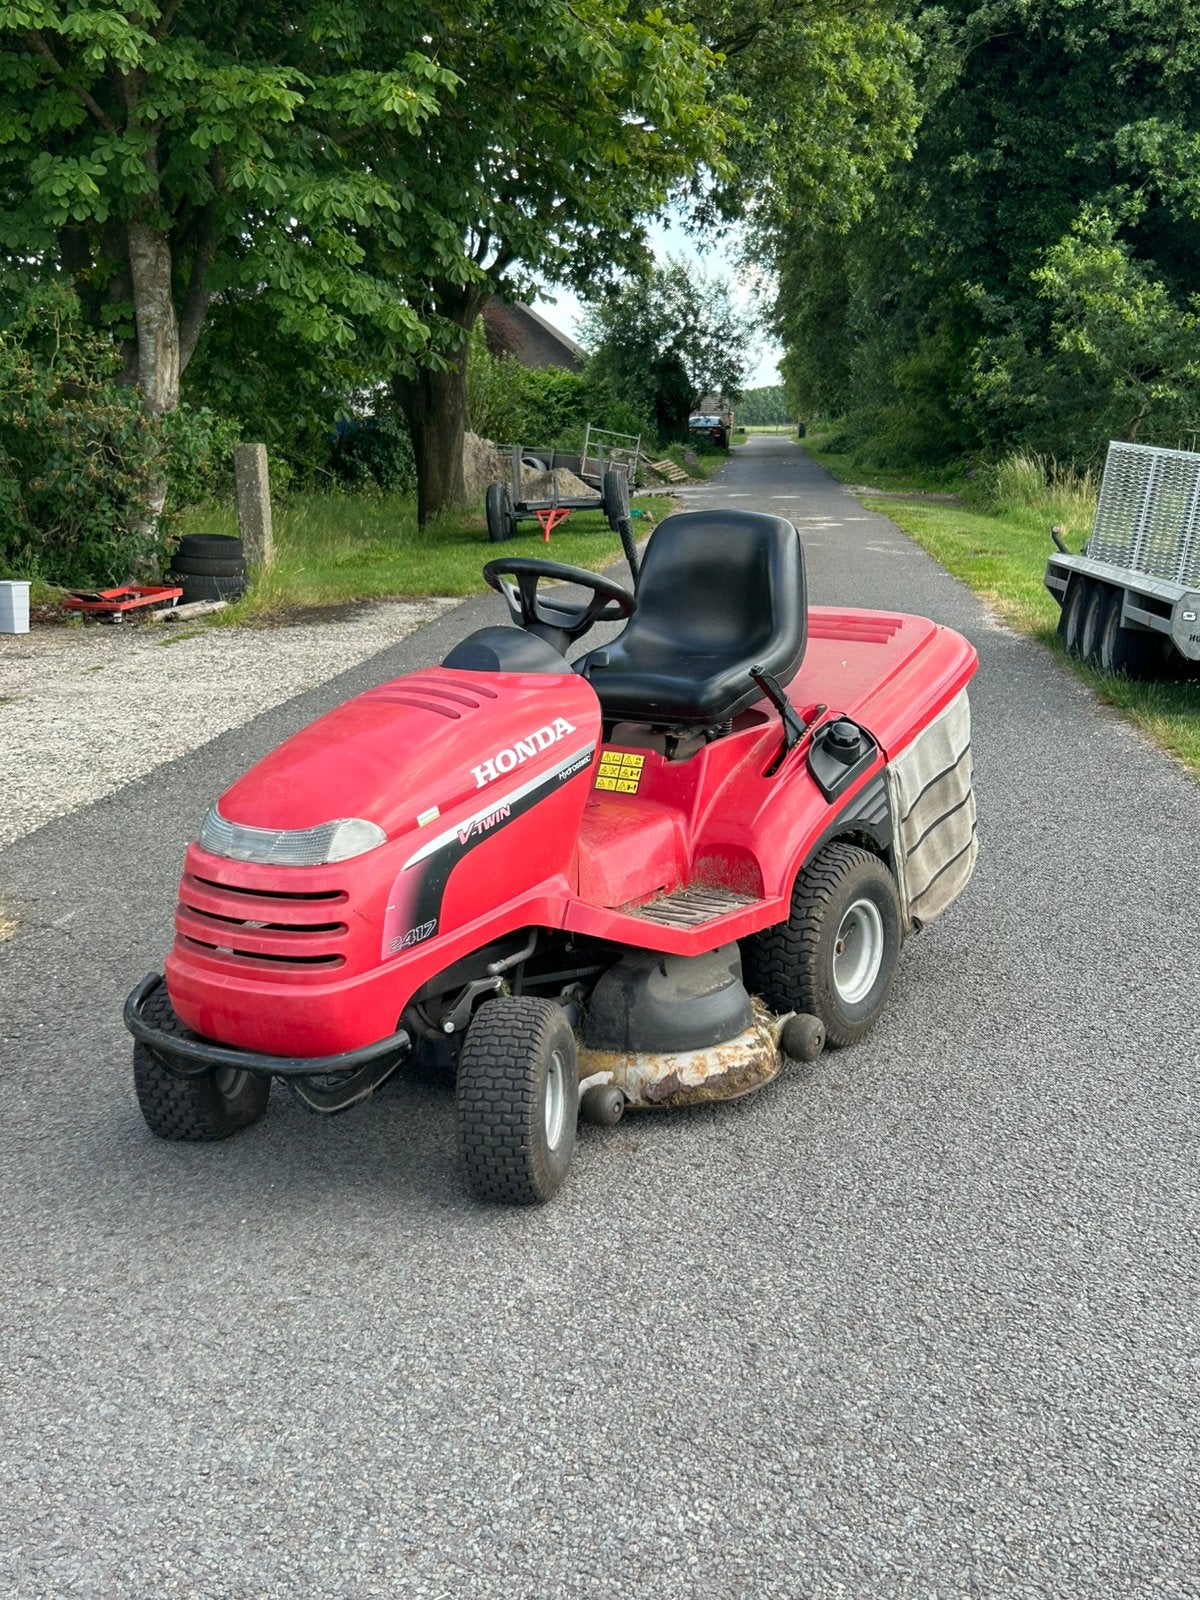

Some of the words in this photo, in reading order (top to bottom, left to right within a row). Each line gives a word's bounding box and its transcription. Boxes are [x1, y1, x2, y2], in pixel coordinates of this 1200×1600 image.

[470, 716, 577, 789] HONDA
[457, 803, 512, 845] V-TWIN
[390, 918, 437, 952] 2417
